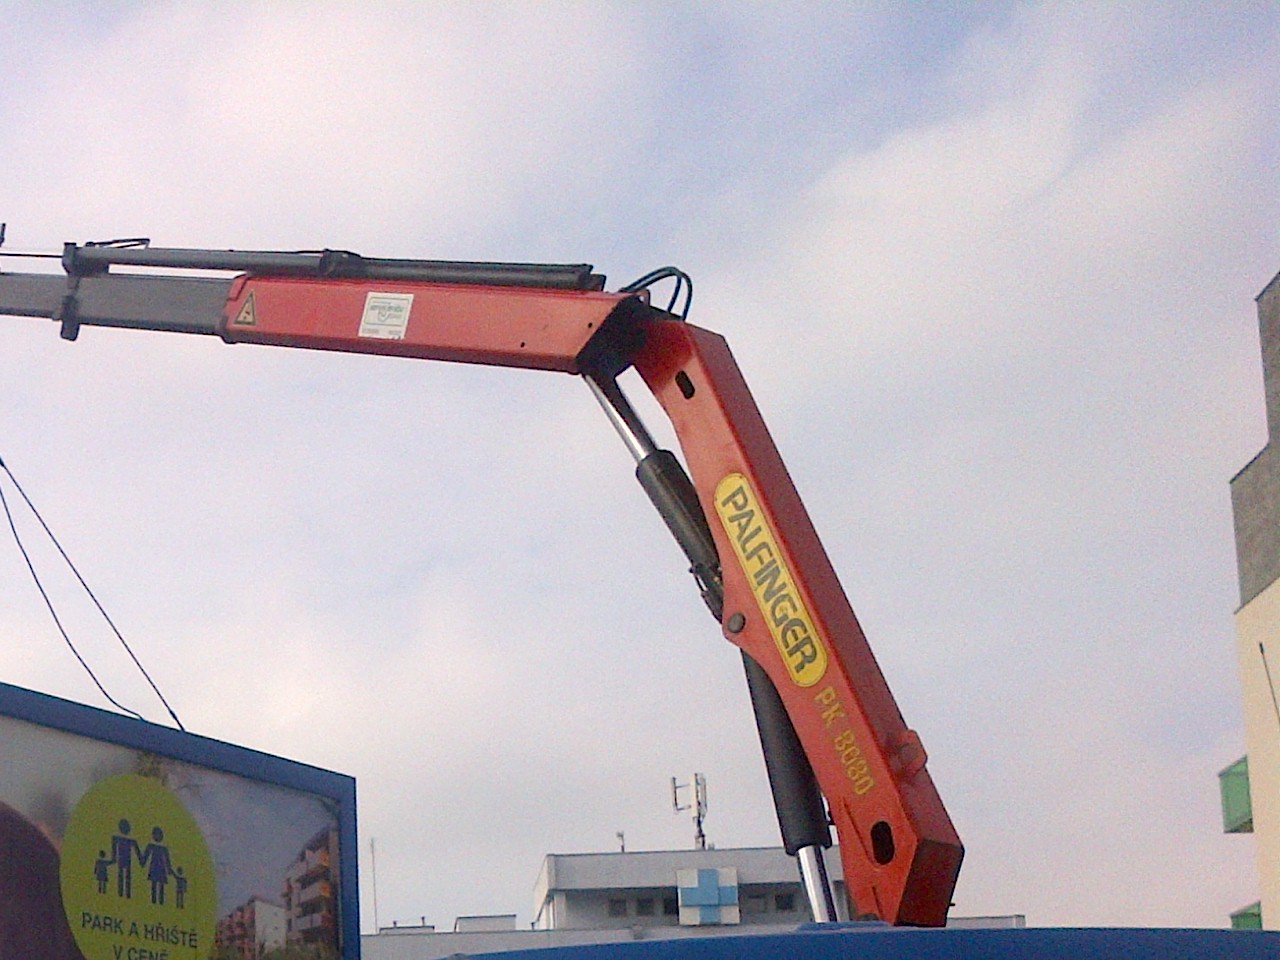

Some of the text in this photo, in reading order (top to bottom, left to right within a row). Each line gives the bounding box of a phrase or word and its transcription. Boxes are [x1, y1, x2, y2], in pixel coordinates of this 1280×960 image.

[721, 486, 819, 674] PALFINGER
[814, 686, 846, 730] PK
[82, 912, 124, 936] PARK
[129, 922, 140, 939] A
[113, 943, 124, 960] V
